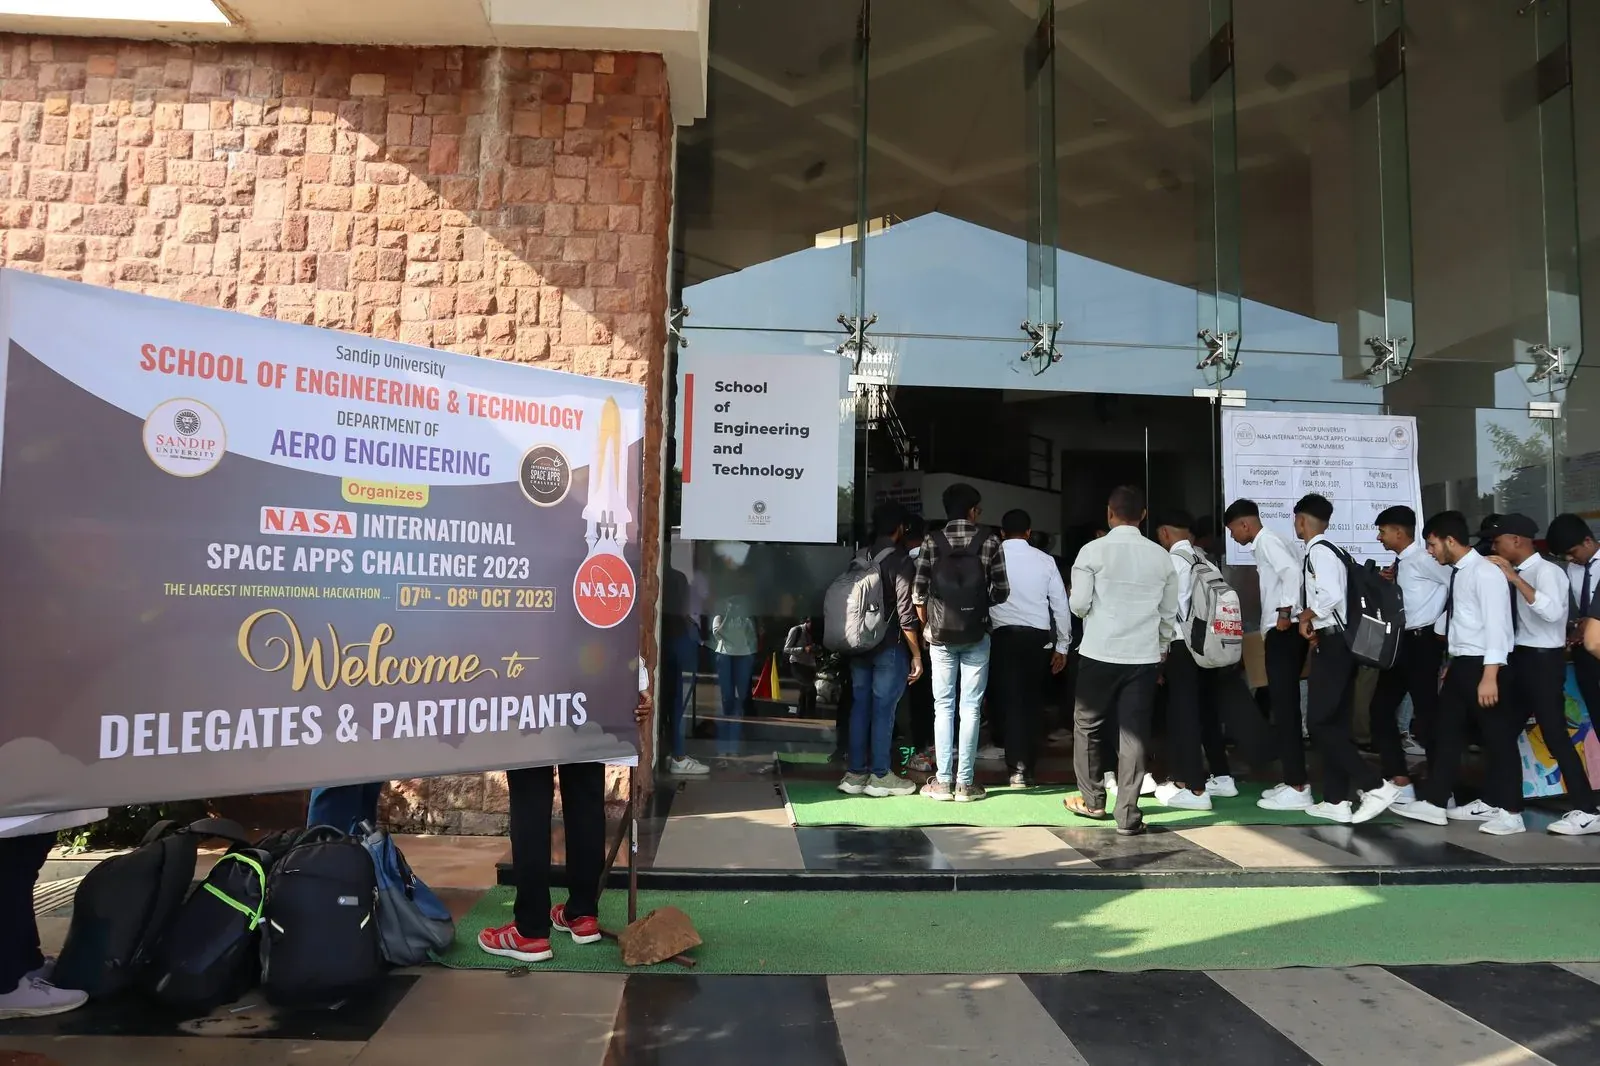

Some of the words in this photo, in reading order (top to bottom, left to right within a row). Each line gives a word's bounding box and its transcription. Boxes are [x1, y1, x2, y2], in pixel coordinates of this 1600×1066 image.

[336, 345, 380, 367] Sandip
[384, 354, 446, 379] University
[140, 343, 248, 385] SCHOOL
[257, 361, 287, 389] OF
[295, 366, 439, 411] ENGINEERING
[447, 389, 460, 414] &
[466, 392, 584, 431] TECHNOLOGY
[714, 380, 768, 394] School
[714, 401, 731, 413] of
[337, 410, 421, 435] DEPARTMENT
[424, 422, 440, 437] OF
[713, 422, 810, 439] Engineering
[1317, 426, 1347, 434] UNIVERSITY
[156, 434, 216, 451] SANDIP
[1272, 433, 1313, 441] INTERNATIONAL
[155, 446, 215, 458] UNIVERSITY
[269, 428, 337, 461] AERO
[343, 434, 490, 477] ENGINEERING
[712, 443, 743, 455] and
[712, 463, 805, 480] Technology
[1324, 459, 1341, 467] Second
[1341, 459, 1354, 467] Floor
[530, 470, 547, 481] SPACE
[547, 471, 561, 482] APPS
[1249, 468, 1280, 477] Participation
[1368, 471, 1381, 479] Right
[1242, 478, 1259, 486] Rooms
[347, 482, 424, 501] Organizes
[1259, 511, 1278, 519] Ground
[1278, 511, 1291, 519] Floor
[1371, 502, 1382, 511] Right
[264, 508, 353, 535] NASA
[363, 513, 516, 546] INTERNATIONAL
[1348, 545, 1362, 554] Wing
[206, 542, 286, 571] SPACE
[292, 546, 354, 574] APPS
[361, 549, 478, 578] CHALLENGE
[482, 555, 530, 580] 2023
[163, 582, 186, 596] THE
[189, 583, 237, 597] LARGEST
[239, 585, 320, 598] INTERNATIONAL
[323, 587, 381, 600] HACKATHON
[400, 586, 431, 607] 07th
[447, 587, 478, 608] 08th
[481, 588, 512, 608] OCT
[515, 589, 553, 609] 2023
[579, 581, 631, 598] NASA
[237, 608, 498, 692] Welcome
[501, 650, 540, 680] to
[99, 703, 323, 760] DELEGATES
[336, 707, 358, 744] &
[372, 692, 587, 741] PARTICIPANTS
